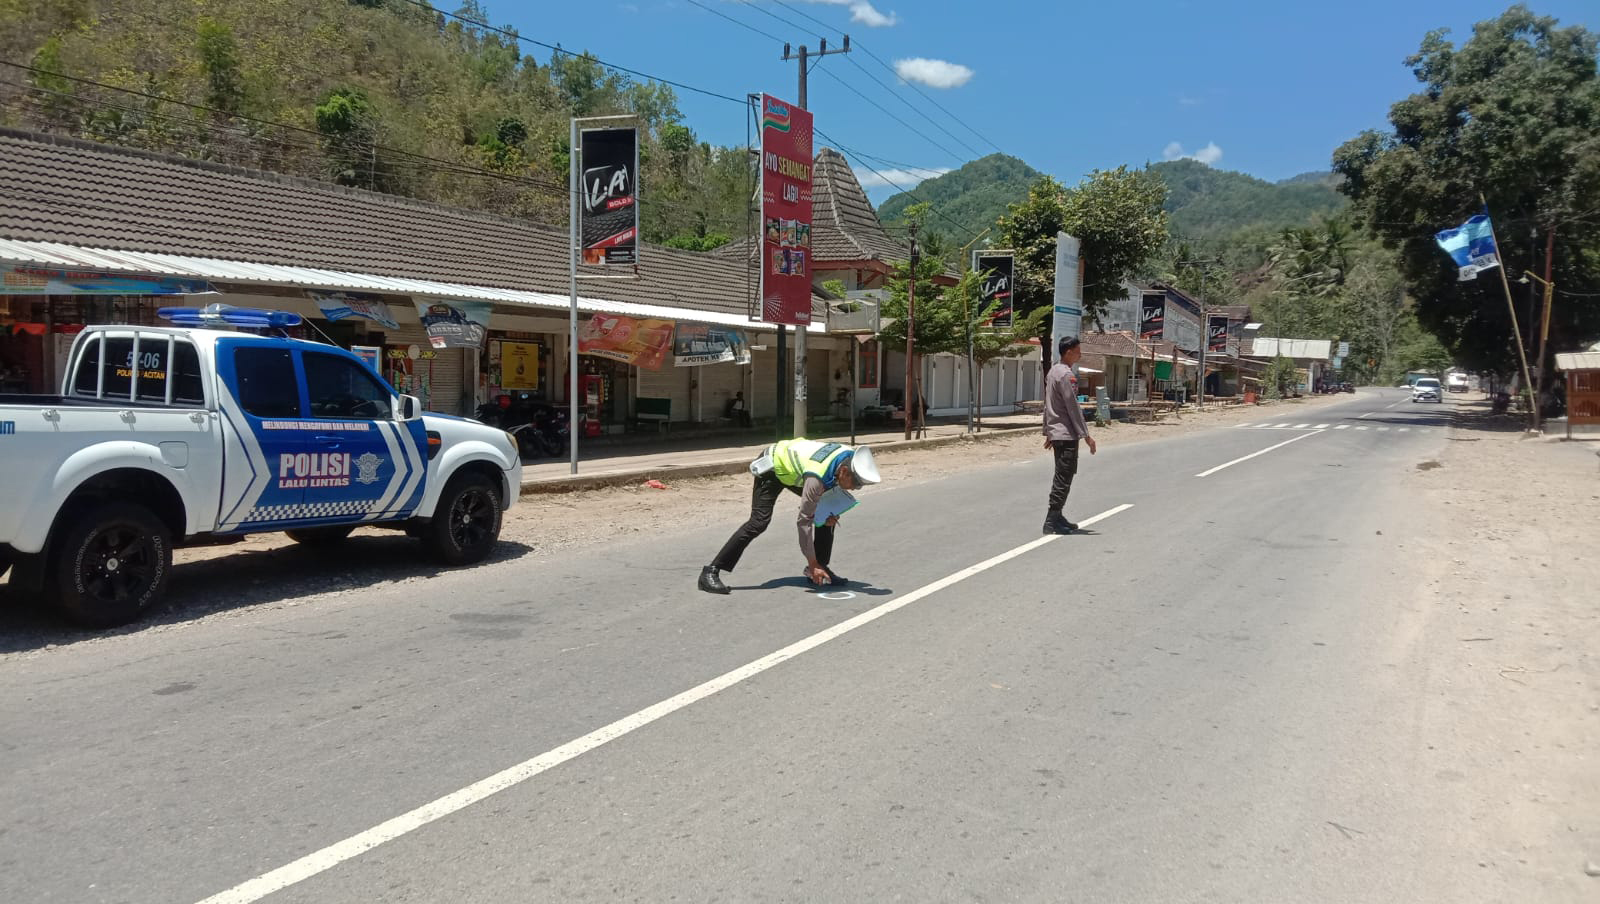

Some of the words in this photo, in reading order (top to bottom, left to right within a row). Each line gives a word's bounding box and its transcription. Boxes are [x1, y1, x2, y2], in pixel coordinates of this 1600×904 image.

[765, 151, 778, 172] AYO
[778, 156, 811, 182] SEMANGAT
[140, 370, 166, 380] ACITAN
[279, 452, 350, 477] POLISI
[279, 479, 308, 489] LALU
[310, 478, 350, 488] LINTAS
